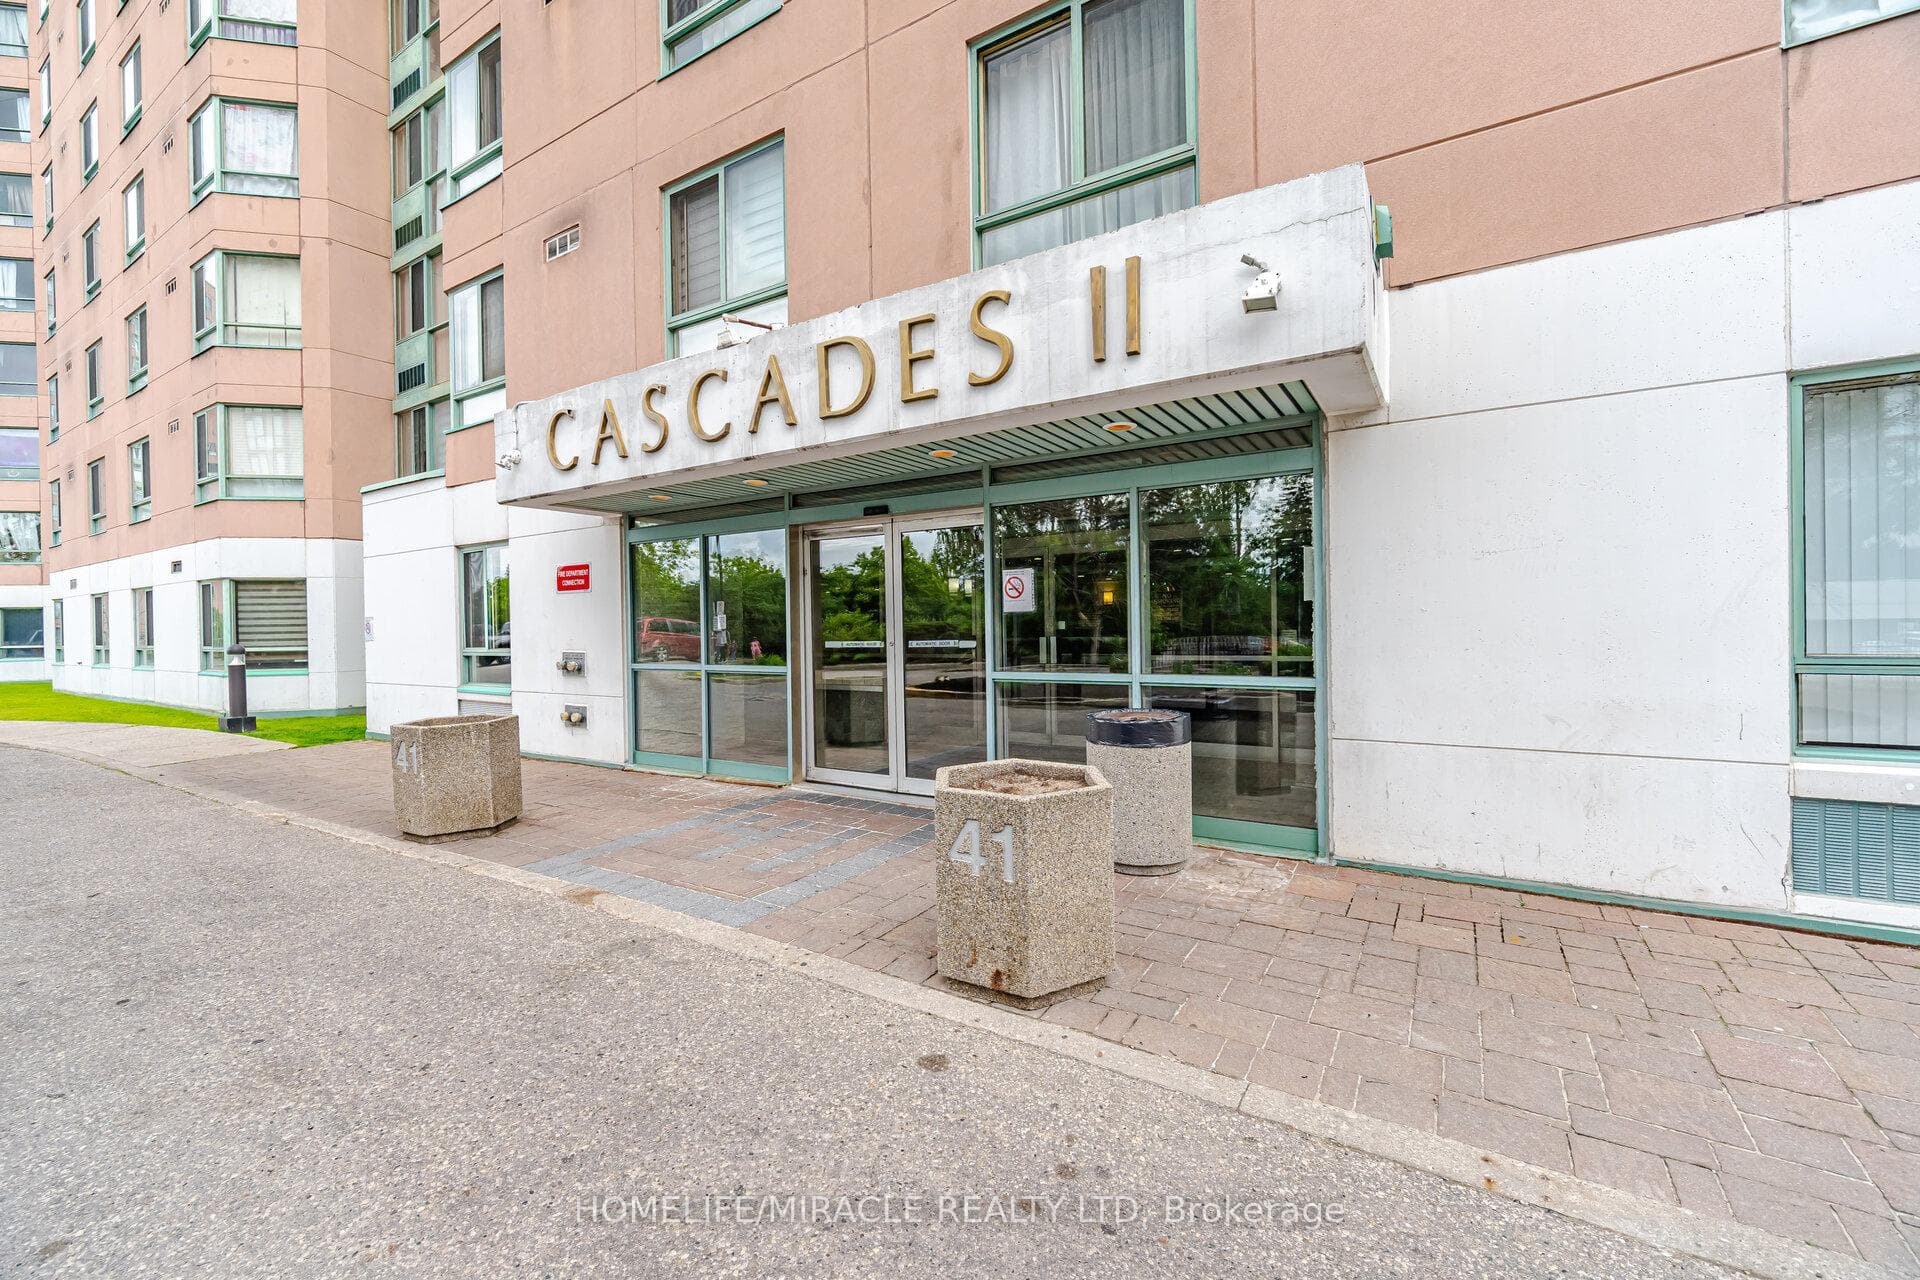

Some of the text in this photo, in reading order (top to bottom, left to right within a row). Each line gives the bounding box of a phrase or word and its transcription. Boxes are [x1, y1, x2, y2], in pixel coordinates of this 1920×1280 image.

[546, 256, 1141, 471] CASCADES II
[394, 741, 417, 774] 41
[950, 818, 1015, 883] 41
